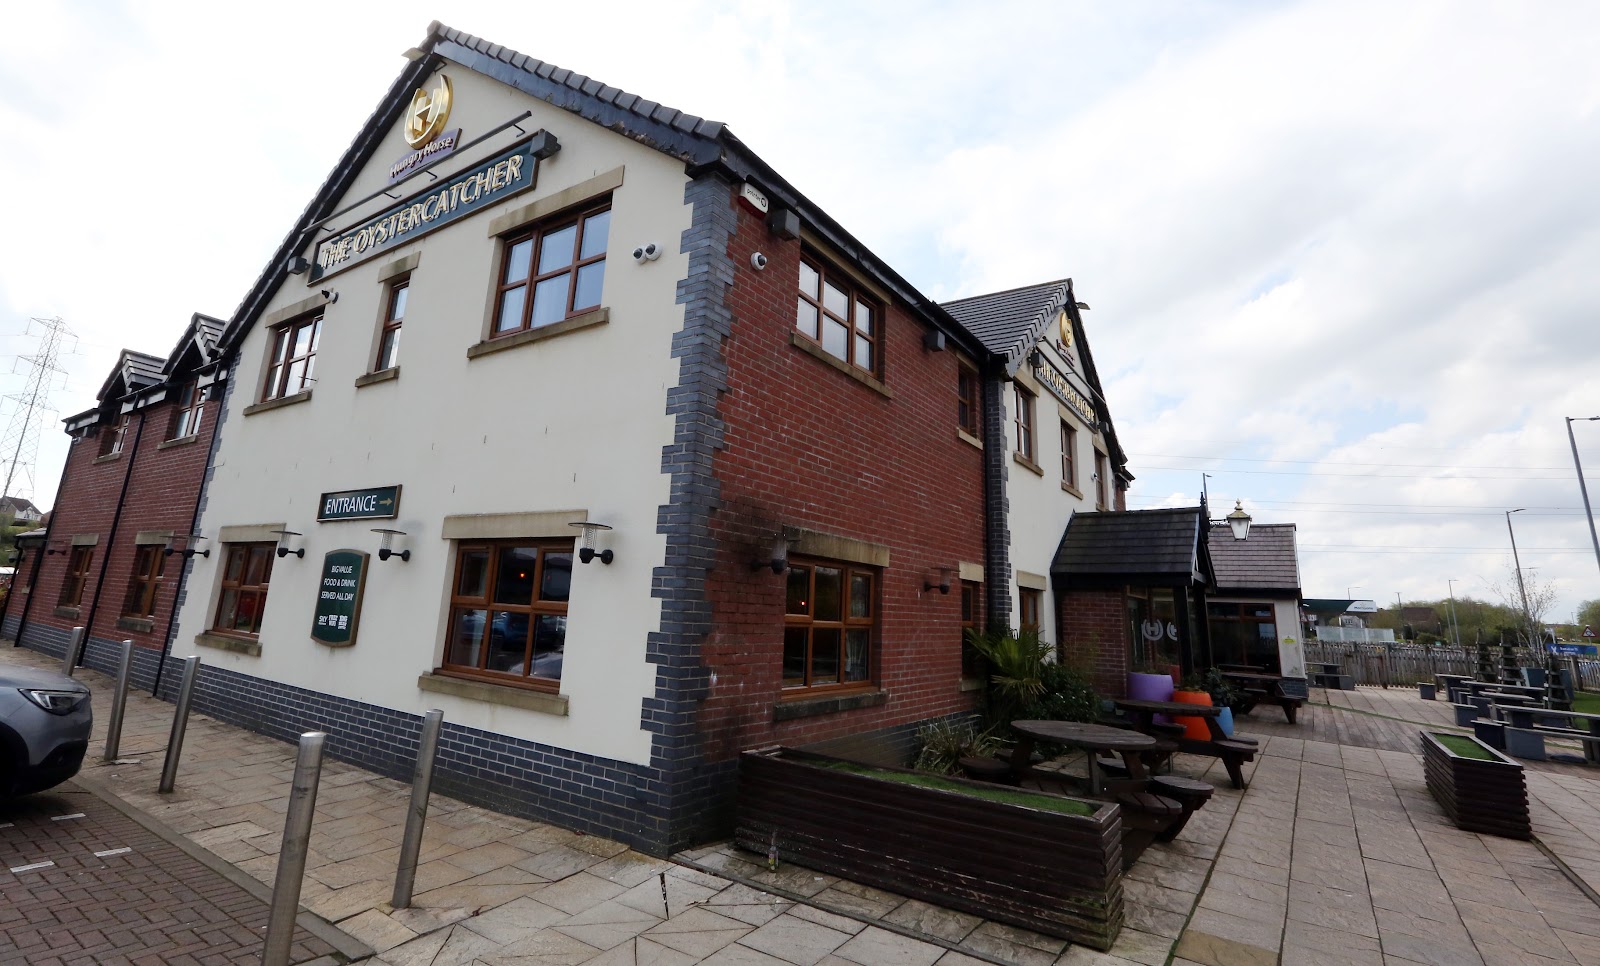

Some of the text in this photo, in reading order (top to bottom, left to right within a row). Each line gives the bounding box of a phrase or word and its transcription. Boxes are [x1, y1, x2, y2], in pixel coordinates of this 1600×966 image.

[389, 136, 454, 178] Hungry Horse
[321, 154, 524, 269] THE OYSTERCATCHER
[325, 495, 377, 514] ENTRANCE
[323, 578, 337, 587] FOOD
[341, 579, 356, 588] DRINK
[321, 591, 354, 601] SERVED ALL DAY
